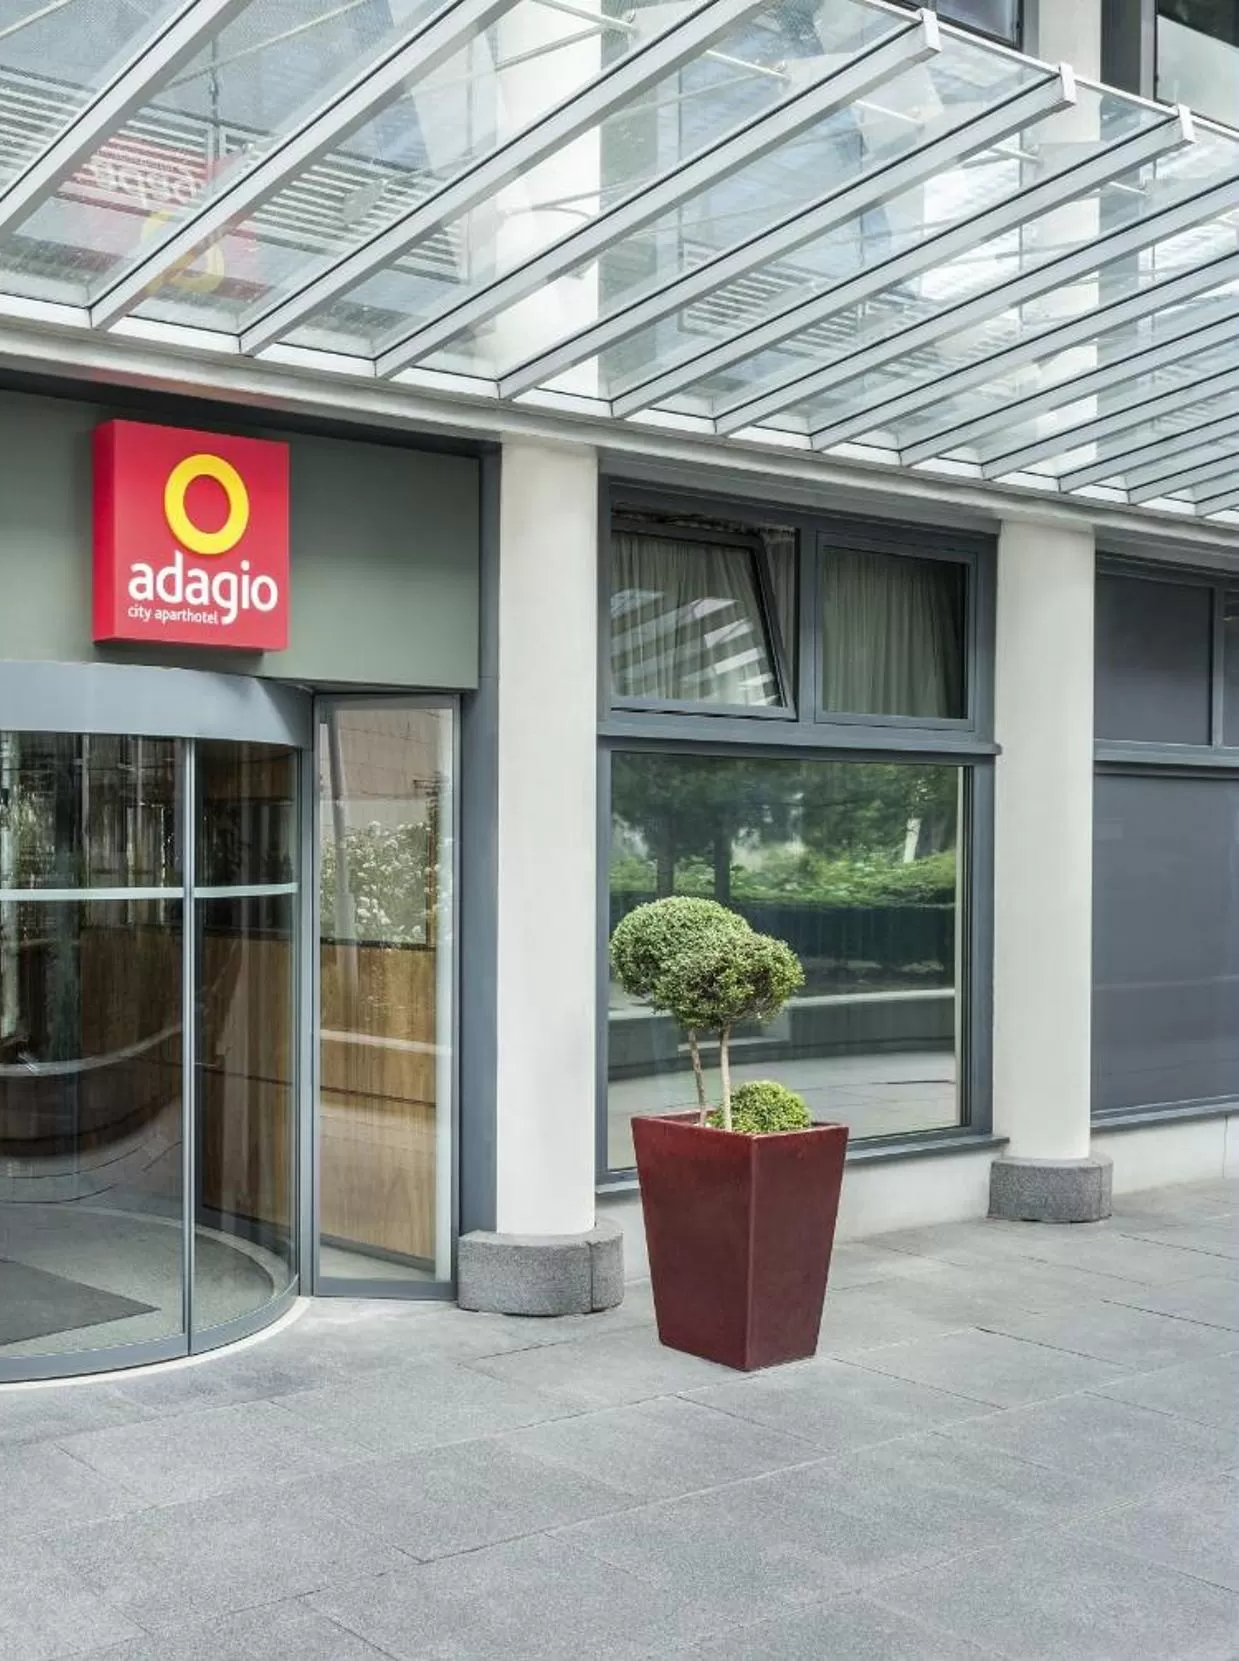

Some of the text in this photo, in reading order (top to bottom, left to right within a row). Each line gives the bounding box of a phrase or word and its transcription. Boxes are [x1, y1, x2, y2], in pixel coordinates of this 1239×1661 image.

[128, 550, 278, 625] adagio
[128, 604, 219, 625] city aparthotel
